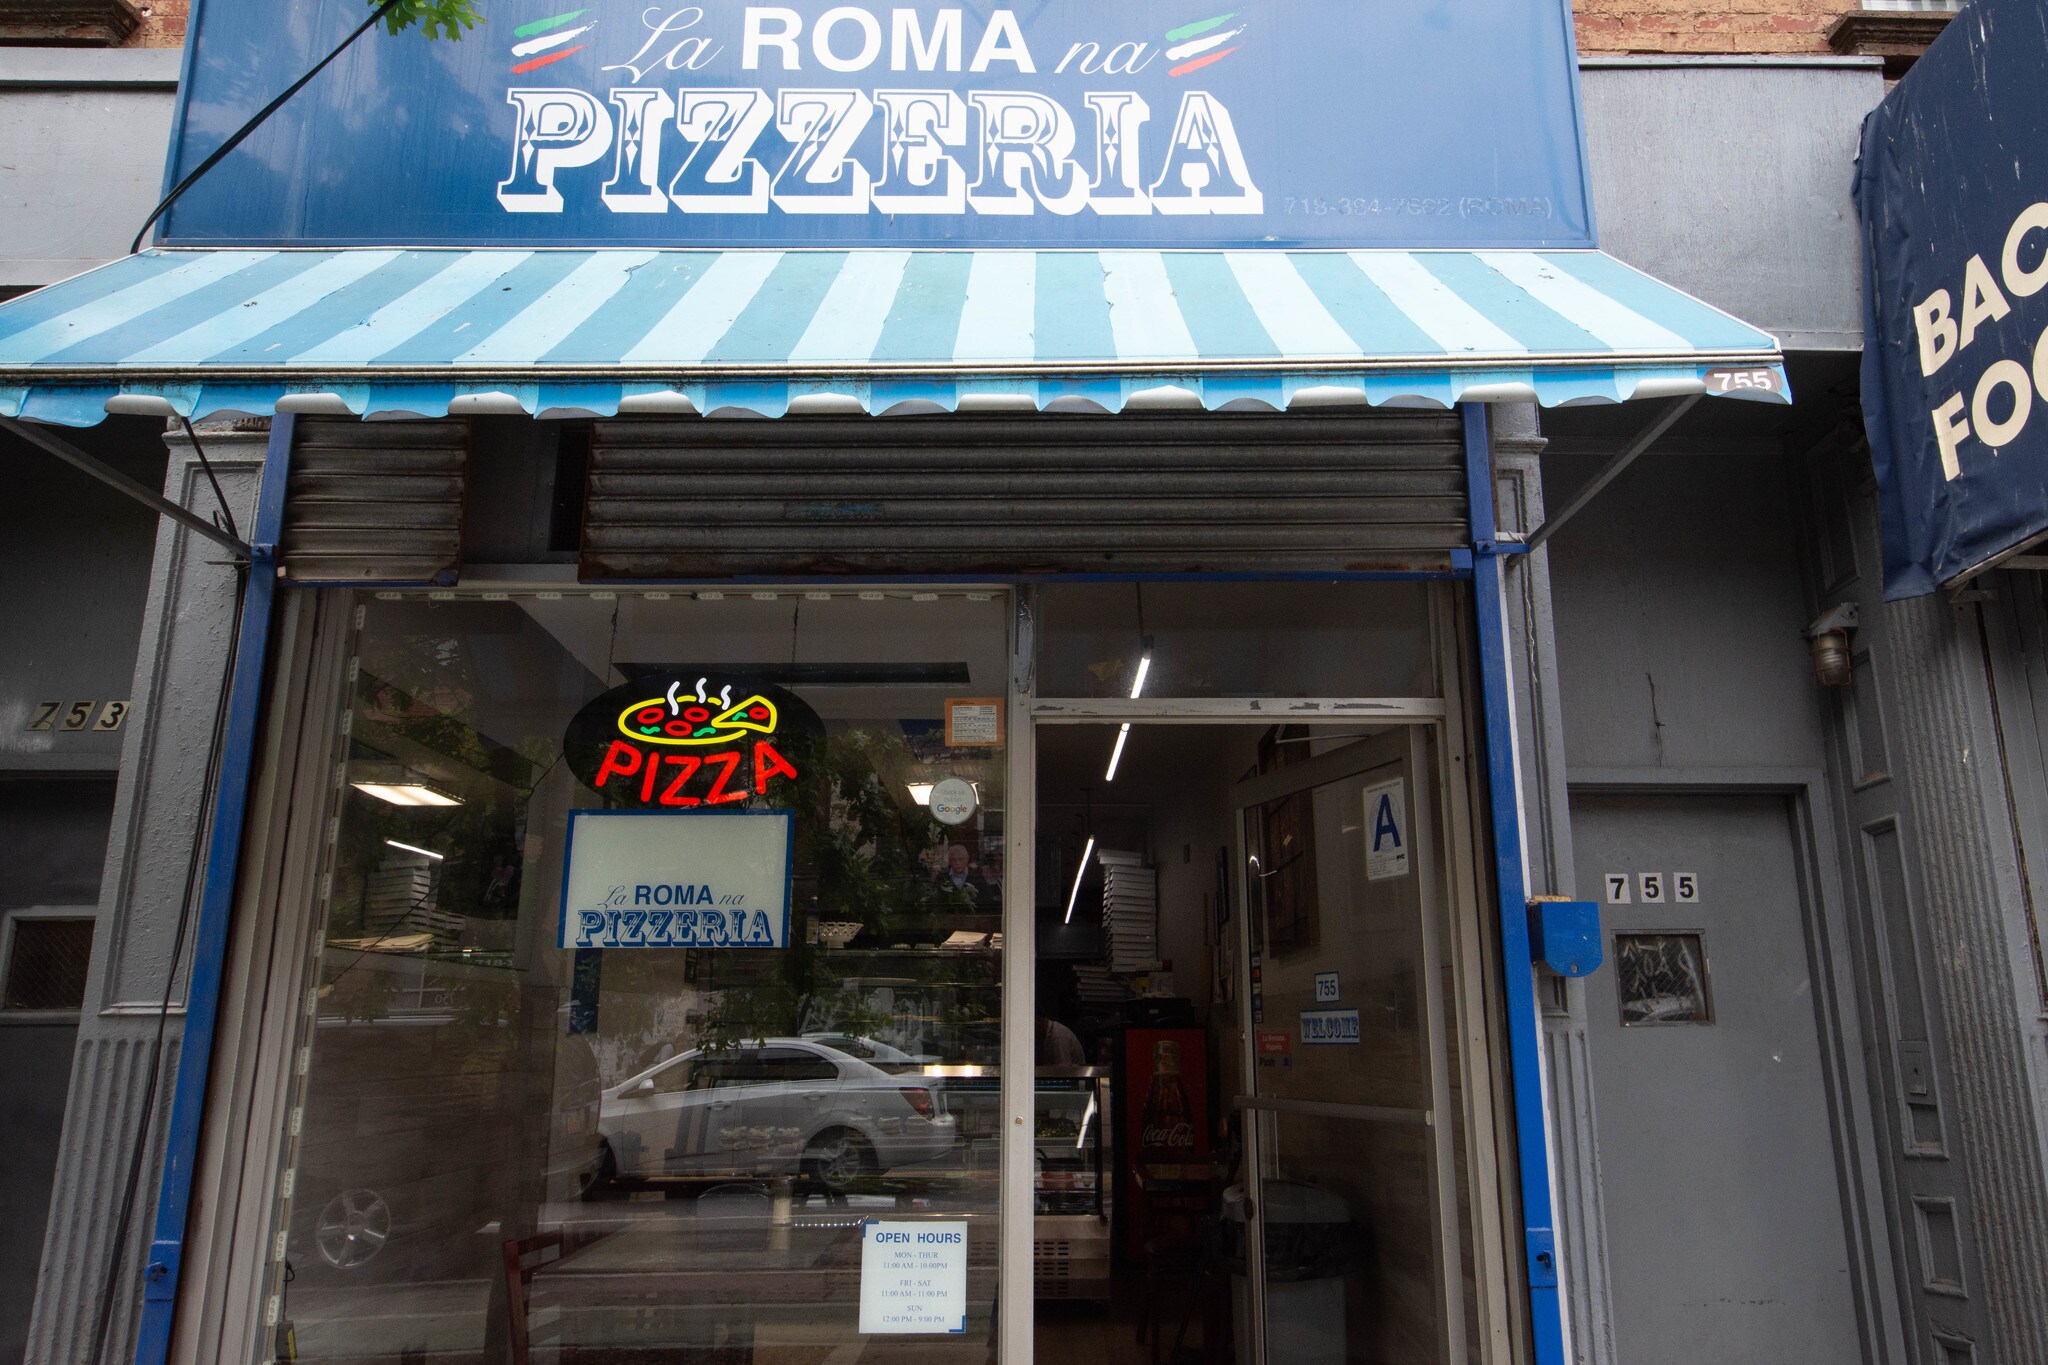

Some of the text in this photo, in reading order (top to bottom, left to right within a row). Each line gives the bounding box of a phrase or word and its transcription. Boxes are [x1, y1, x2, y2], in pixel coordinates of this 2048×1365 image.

[601, 6, 1162, 83] La ROMA na
[497, 87, 1264, 215] PIZZERIA
[1713, 371, 1772, 390] 755
[1932, 325, 2048, 482] FO
[31, 701, 125, 729] 753
[595, 740, 798, 806] PIZZA
[936, 803, 968, 815] Google
[1372, 793, 1402, 852] A
[597, 884, 745, 909] La ROMA na
[1609, 876, 1694, 900] 755
[575, 909, 774, 947] PIZZERIA
[1317, 979, 1336, 996] 755
[1300, 1016, 1360, 1039] WELCOME
[875, 1232, 962, 1244] OPEN HOURS
[894, 1251, 912, 1259] MON
[918, 1251, 939, 1259] THUR
[900, 1279, 912, 1287] FRI
[917, 1279, 932, 1287] SAT
[901, 1315, 912, 1323] PM
[933, 1315, 945, 1323] PM
[906, 1304, 923, 1312] SUN
